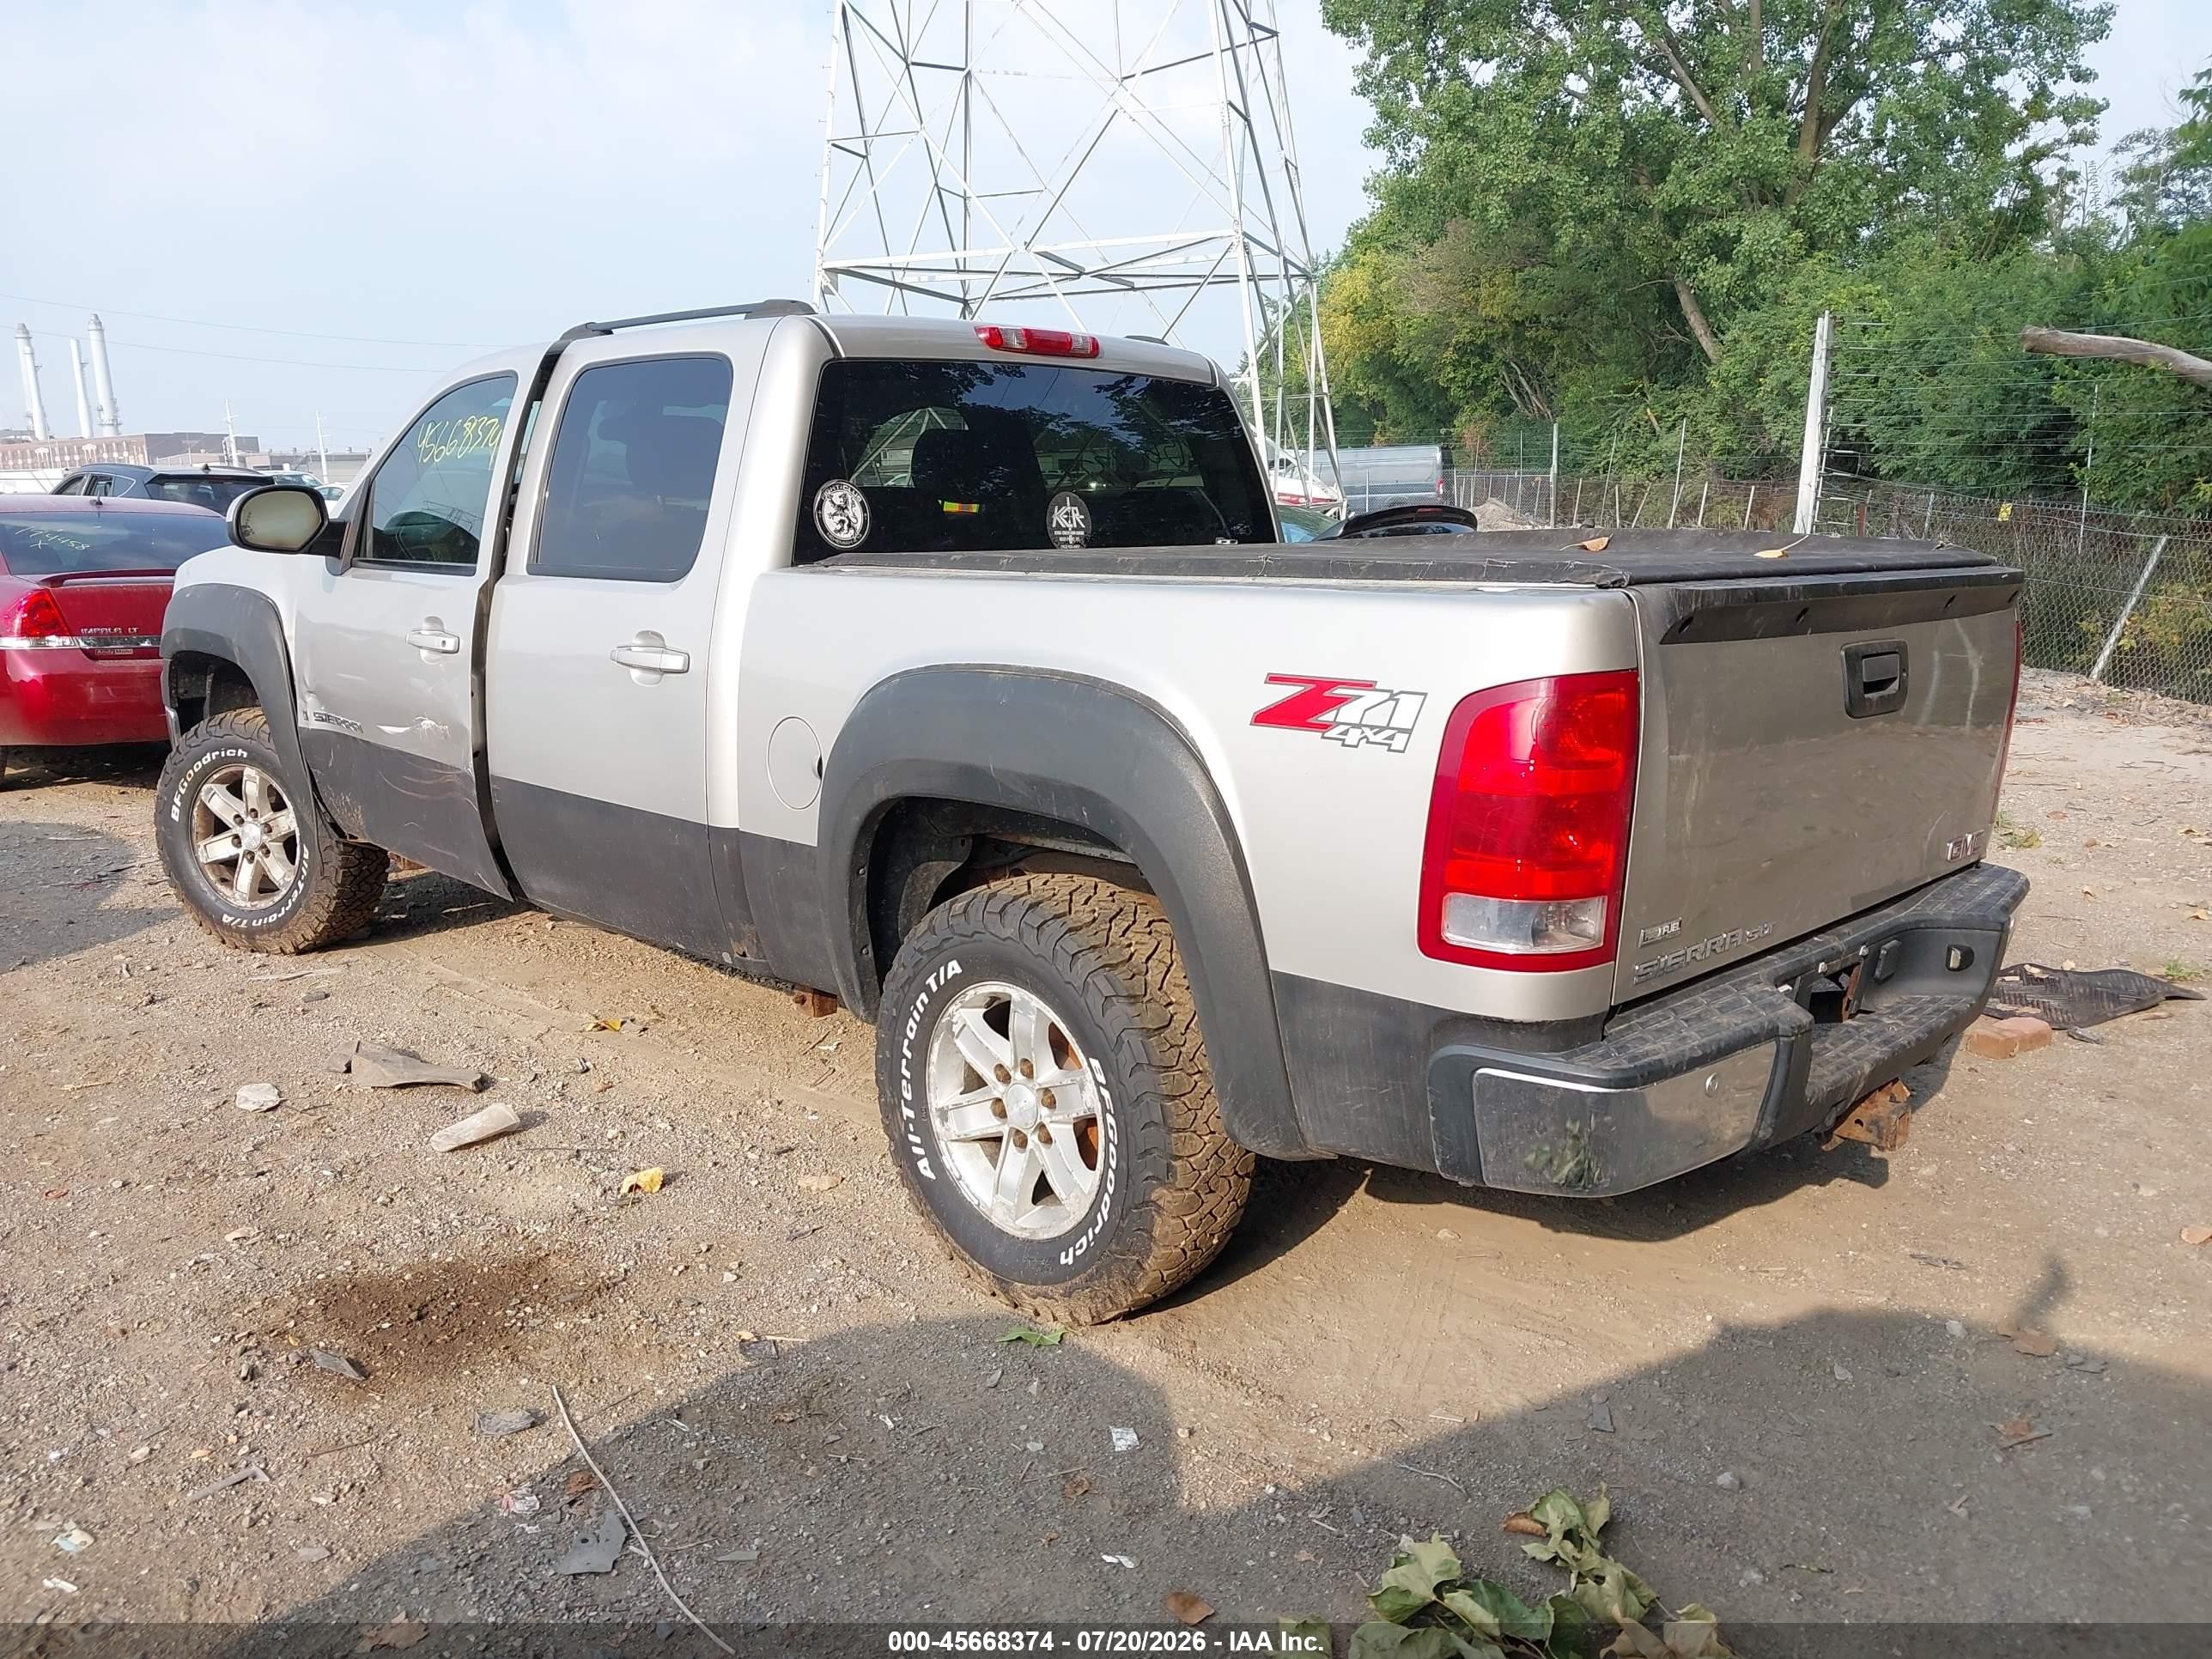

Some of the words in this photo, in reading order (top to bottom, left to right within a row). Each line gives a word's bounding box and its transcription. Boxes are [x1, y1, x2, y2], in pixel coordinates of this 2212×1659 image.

[416, 415, 503, 472] 45668374
[313, 710, 364, 734] SIERRA
[1249, 672, 1428, 735] Z71
[170, 747, 249, 823] BFGoodrich
[1946, 830, 1985, 862] GMC
[221, 912, 249, 929] T/A
[1633, 927, 1743, 986] SIERRA
[901, 994, 937, 1181] All-Terrain
[925, 958, 963, 994] T/A
[1059, 1056, 1119, 1267] BFGoodrich
